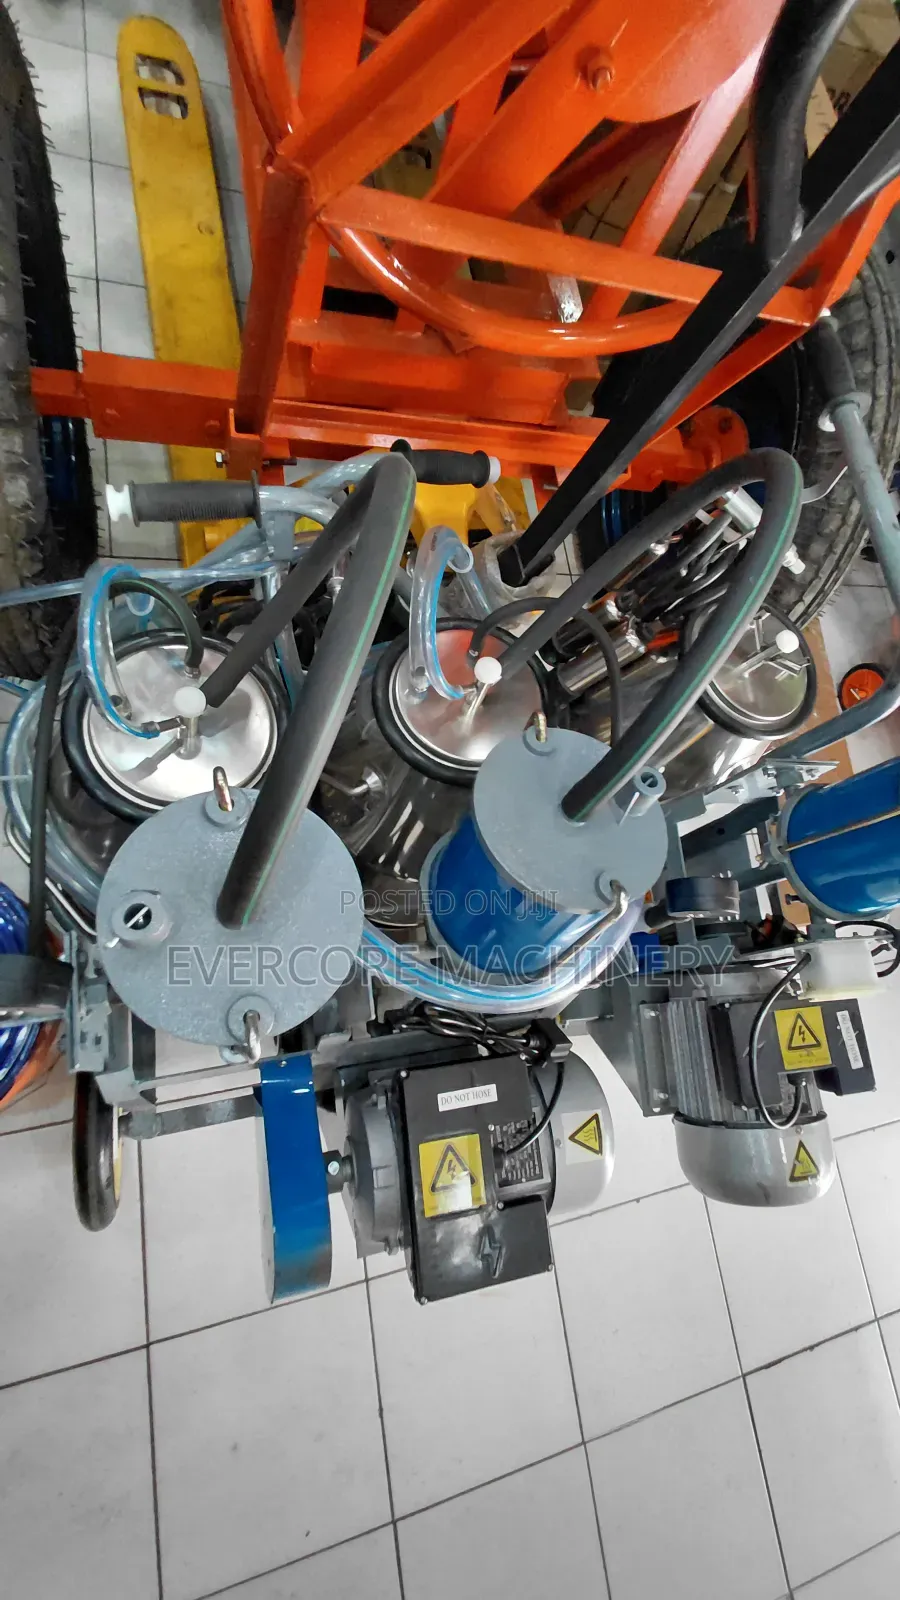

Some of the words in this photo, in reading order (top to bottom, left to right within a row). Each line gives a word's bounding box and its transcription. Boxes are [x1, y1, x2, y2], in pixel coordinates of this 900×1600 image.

[440, 1096, 452, 1106] DO
[454, 1093, 470, 1102] NOT
[472, 1089, 491, 1099] HOSE
